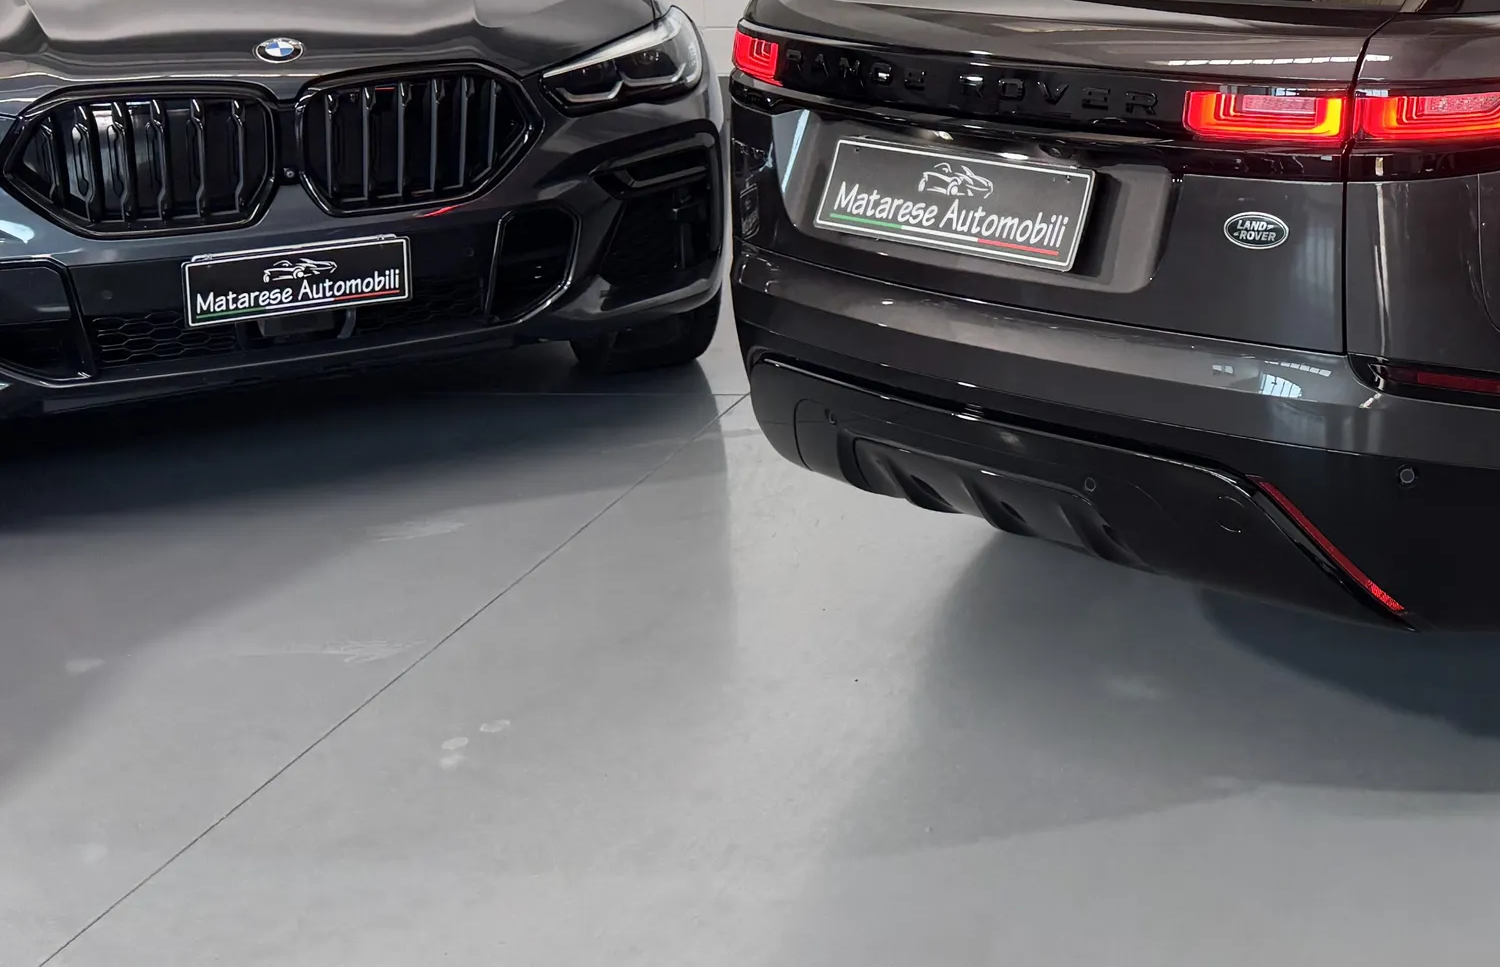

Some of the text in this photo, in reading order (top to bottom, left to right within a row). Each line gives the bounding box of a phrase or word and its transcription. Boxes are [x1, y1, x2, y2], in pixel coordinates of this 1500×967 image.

[785, 47, 1159, 116] RANGE ROVER
[833, 181, 1070, 248] Matarese Automobili
[1236, 219, 1268, 231] LAND
[1239, 230, 1277, 241] ROVER
[196, 268, 400, 315] Matarese Automobili
